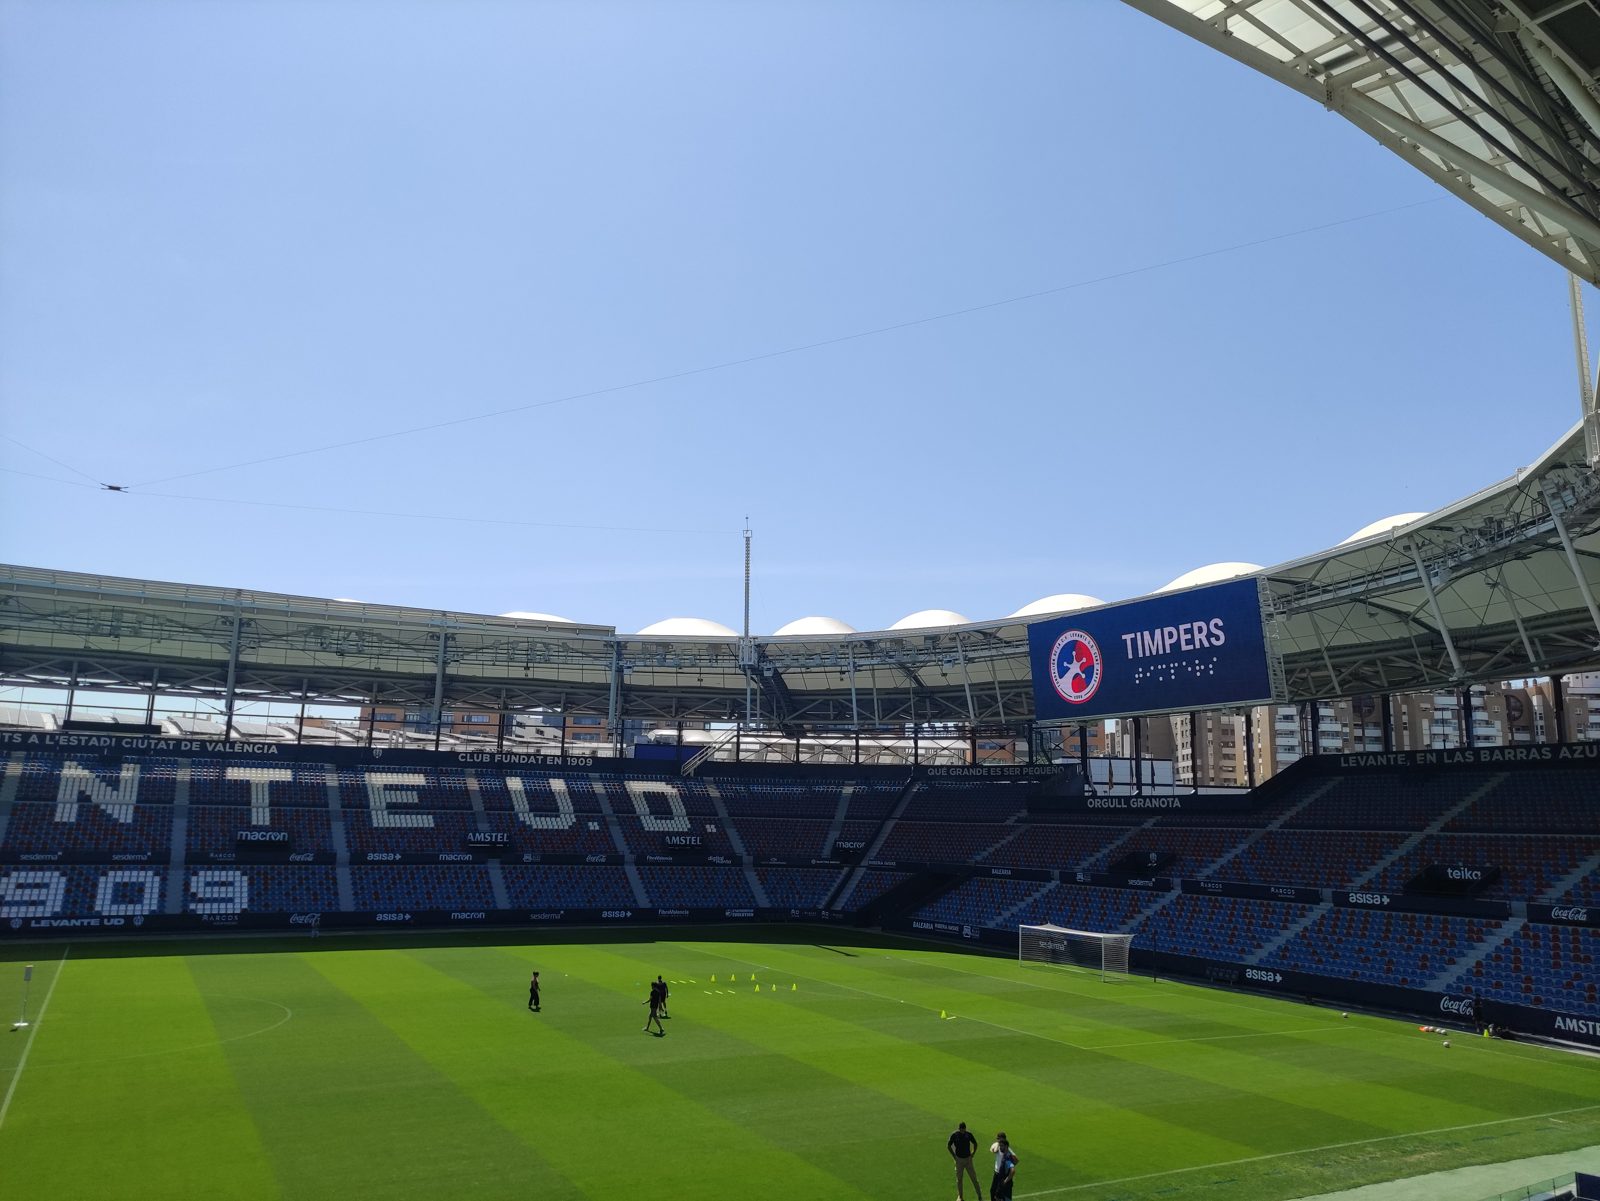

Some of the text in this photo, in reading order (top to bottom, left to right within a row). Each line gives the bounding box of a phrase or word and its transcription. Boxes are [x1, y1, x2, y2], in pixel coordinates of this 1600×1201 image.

[1121, 618, 1226, 659] TIMPERS
[0, 732, 22, 743] TS
[27, 734, 39, 744] A
[121, 738, 176, 750] CIUTAT
[181, 741, 200, 751] DE
[206, 741, 278, 754] VALÈNCIA
[1416, 752, 1437, 764] EN
[1444, 751, 1474, 763] LAS
[1481, 747, 1552, 762] BARRAS
[1559, 745, 1600, 759] AZU
[458, 753, 593, 767] CLUB FUNDAT EN 1909
[949, 767, 988, 776] GRANDE
[990, 767, 1001, 776] ES
[1003, 767, 1021, 776] SER
[1087, 798, 1181, 809] ORGULL GRANOTA
[237, 831, 288, 841] macron
[467, 832, 509, 842] AMSTEL
[664, 835, 702, 845] AMSTEL
[367, 853, 395, 861] asisa
[439, 853, 473, 861] macron
[1447, 868, 1482, 880] teika
[1349, 893, 1381, 905] asisa
[376, 913, 404, 921] asisa
[451, 912, 485, 920] macron
[31, 918, 125, 927] LEVANTE UD
[1245, 968, 1275, 982] asisa
